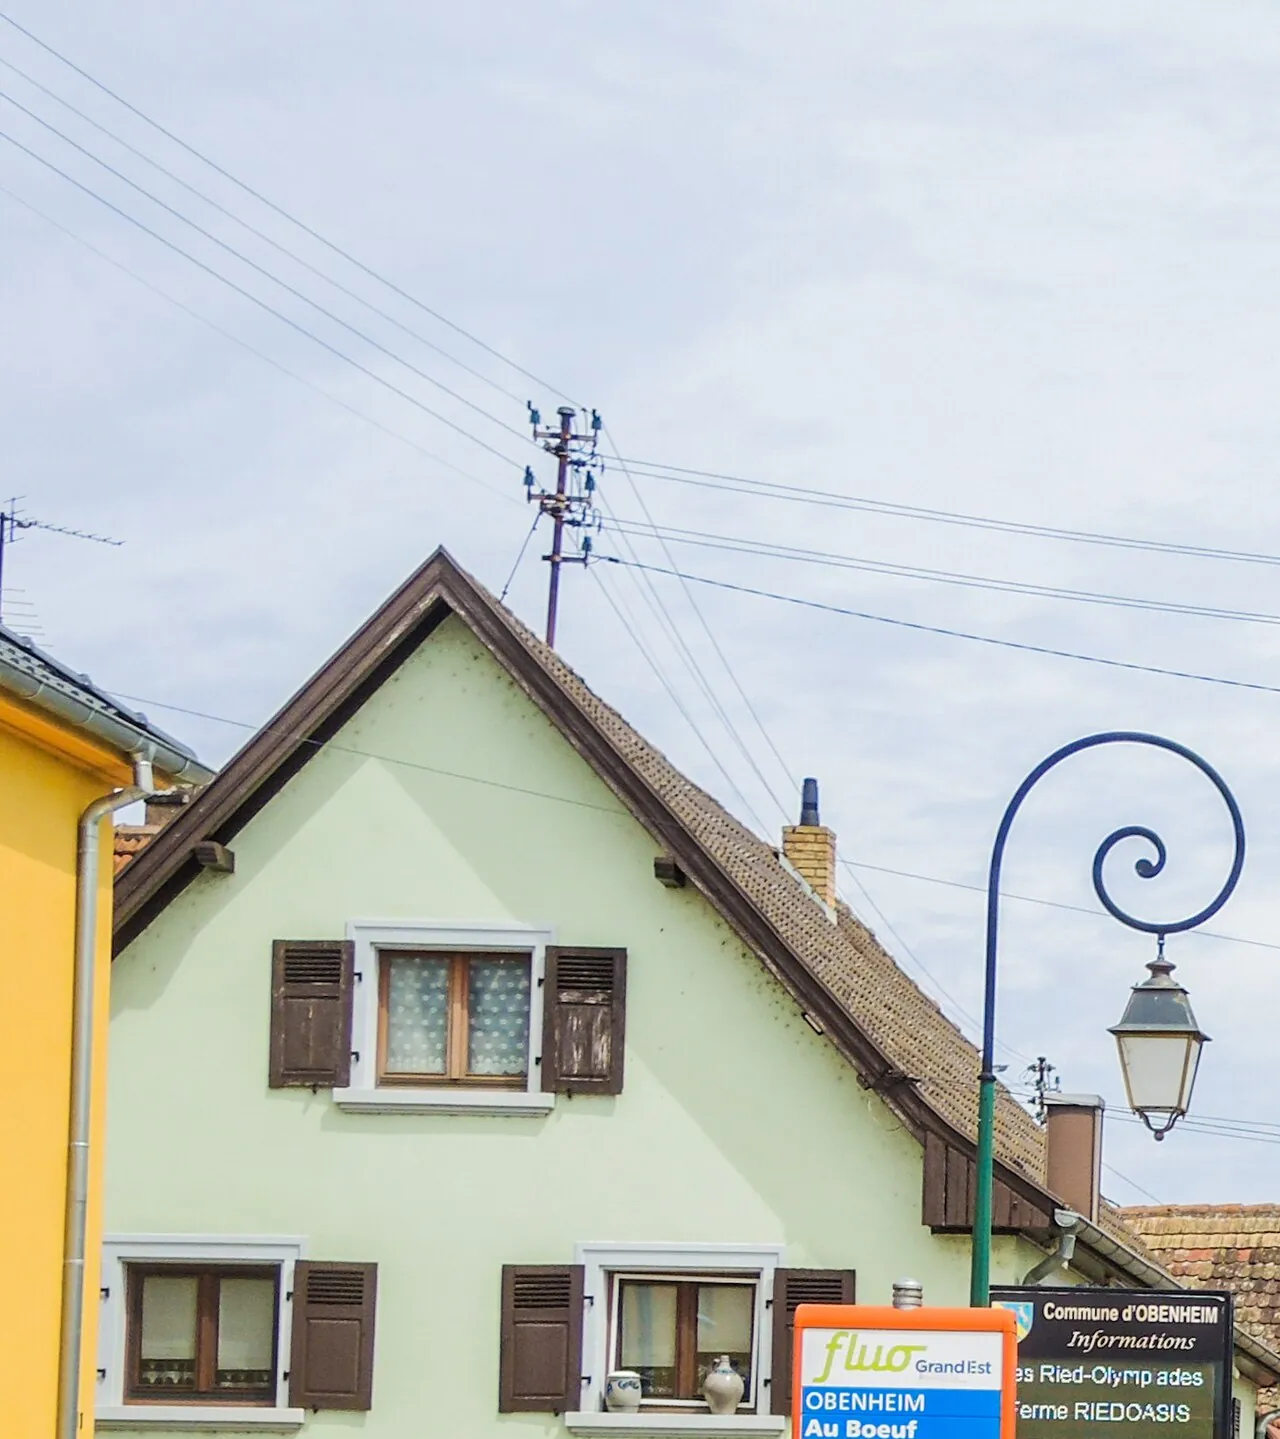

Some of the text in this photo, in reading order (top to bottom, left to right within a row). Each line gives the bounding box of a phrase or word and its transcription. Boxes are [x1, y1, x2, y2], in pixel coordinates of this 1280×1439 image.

[1043, 1302, 1218, 1325] Commune d'OBENHEIM
[1067, 1330, 1196, 1353] Informations
[812, 1330, 928, 1383] fluo
[1015, 1368, 1035, 1384] es
[805, 1391, 926, 1412] OBENHEIM
[1074, 1402, 1191, 1423] RIEDOASIS
[804, 1418, 918, 1439] Au Boeuf
